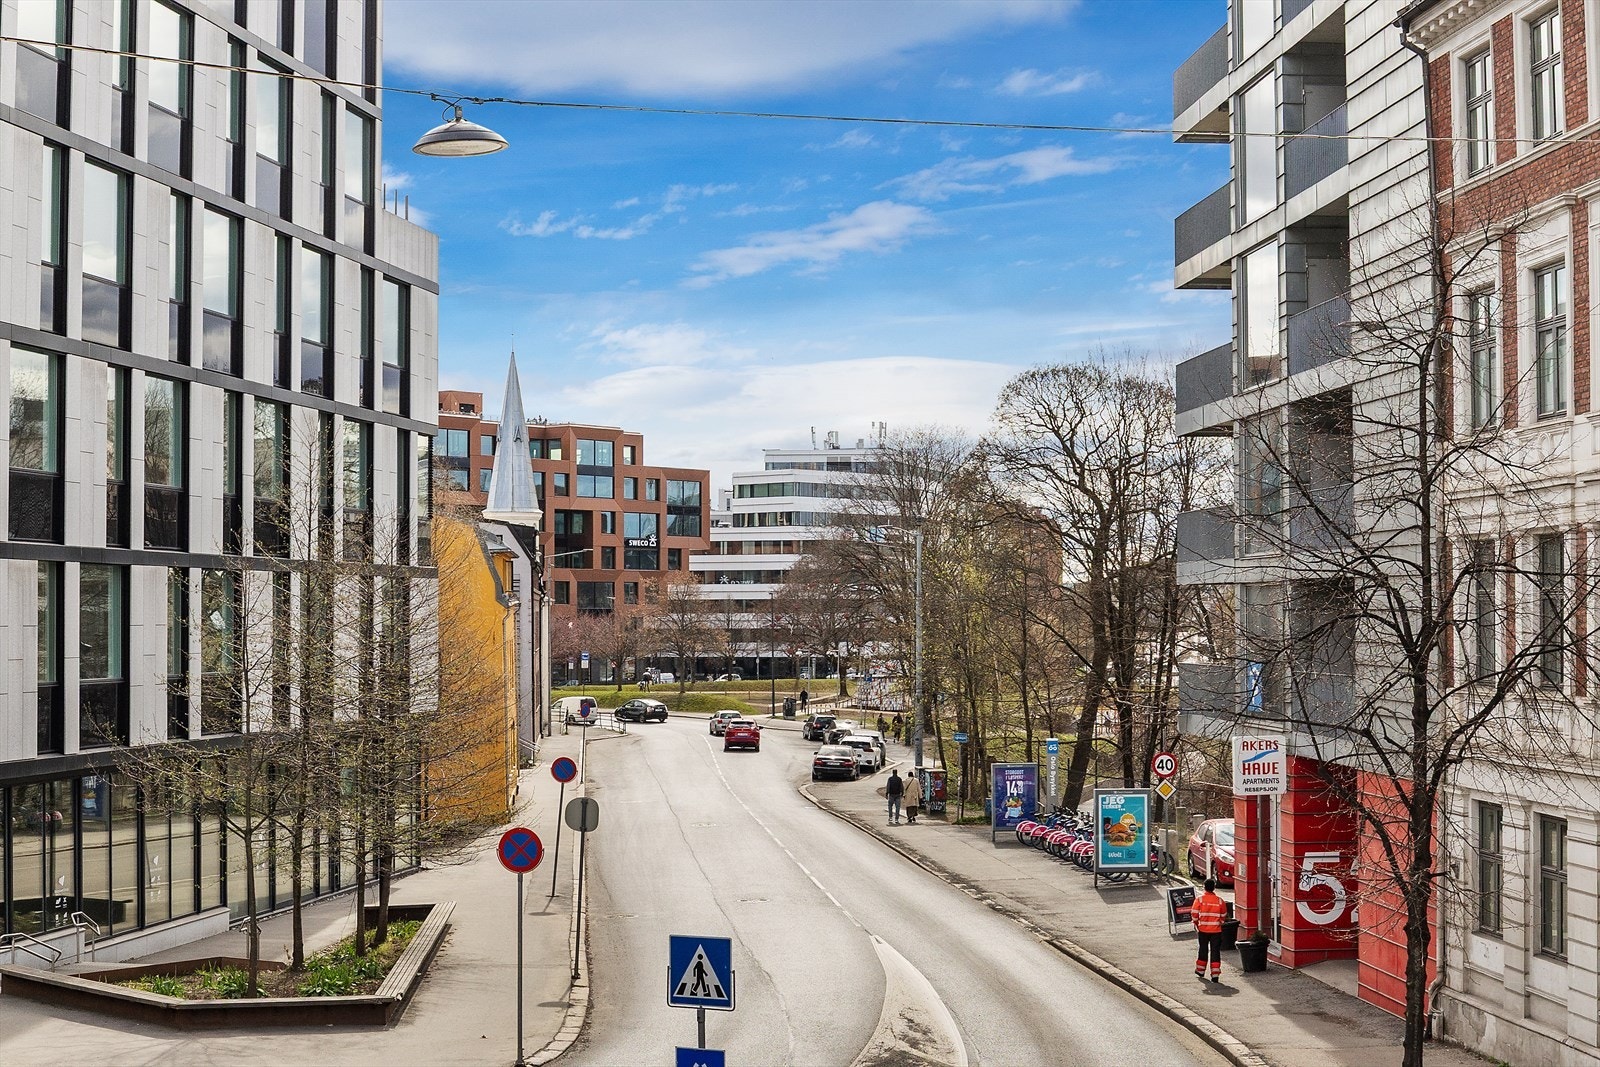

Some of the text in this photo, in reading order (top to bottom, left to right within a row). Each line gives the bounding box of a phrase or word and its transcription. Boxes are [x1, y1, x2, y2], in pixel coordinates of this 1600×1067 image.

[628, 539, 649, 547] SWECO
[1242, 740, 1279, 751] AKERS
[1156, 758, 1174, 772] 40
[1242, 777, 1280, 785] APARTMENTS
[1102, 796, 1125, 805] JEG
[1296, 851, 1358, 925] 5
